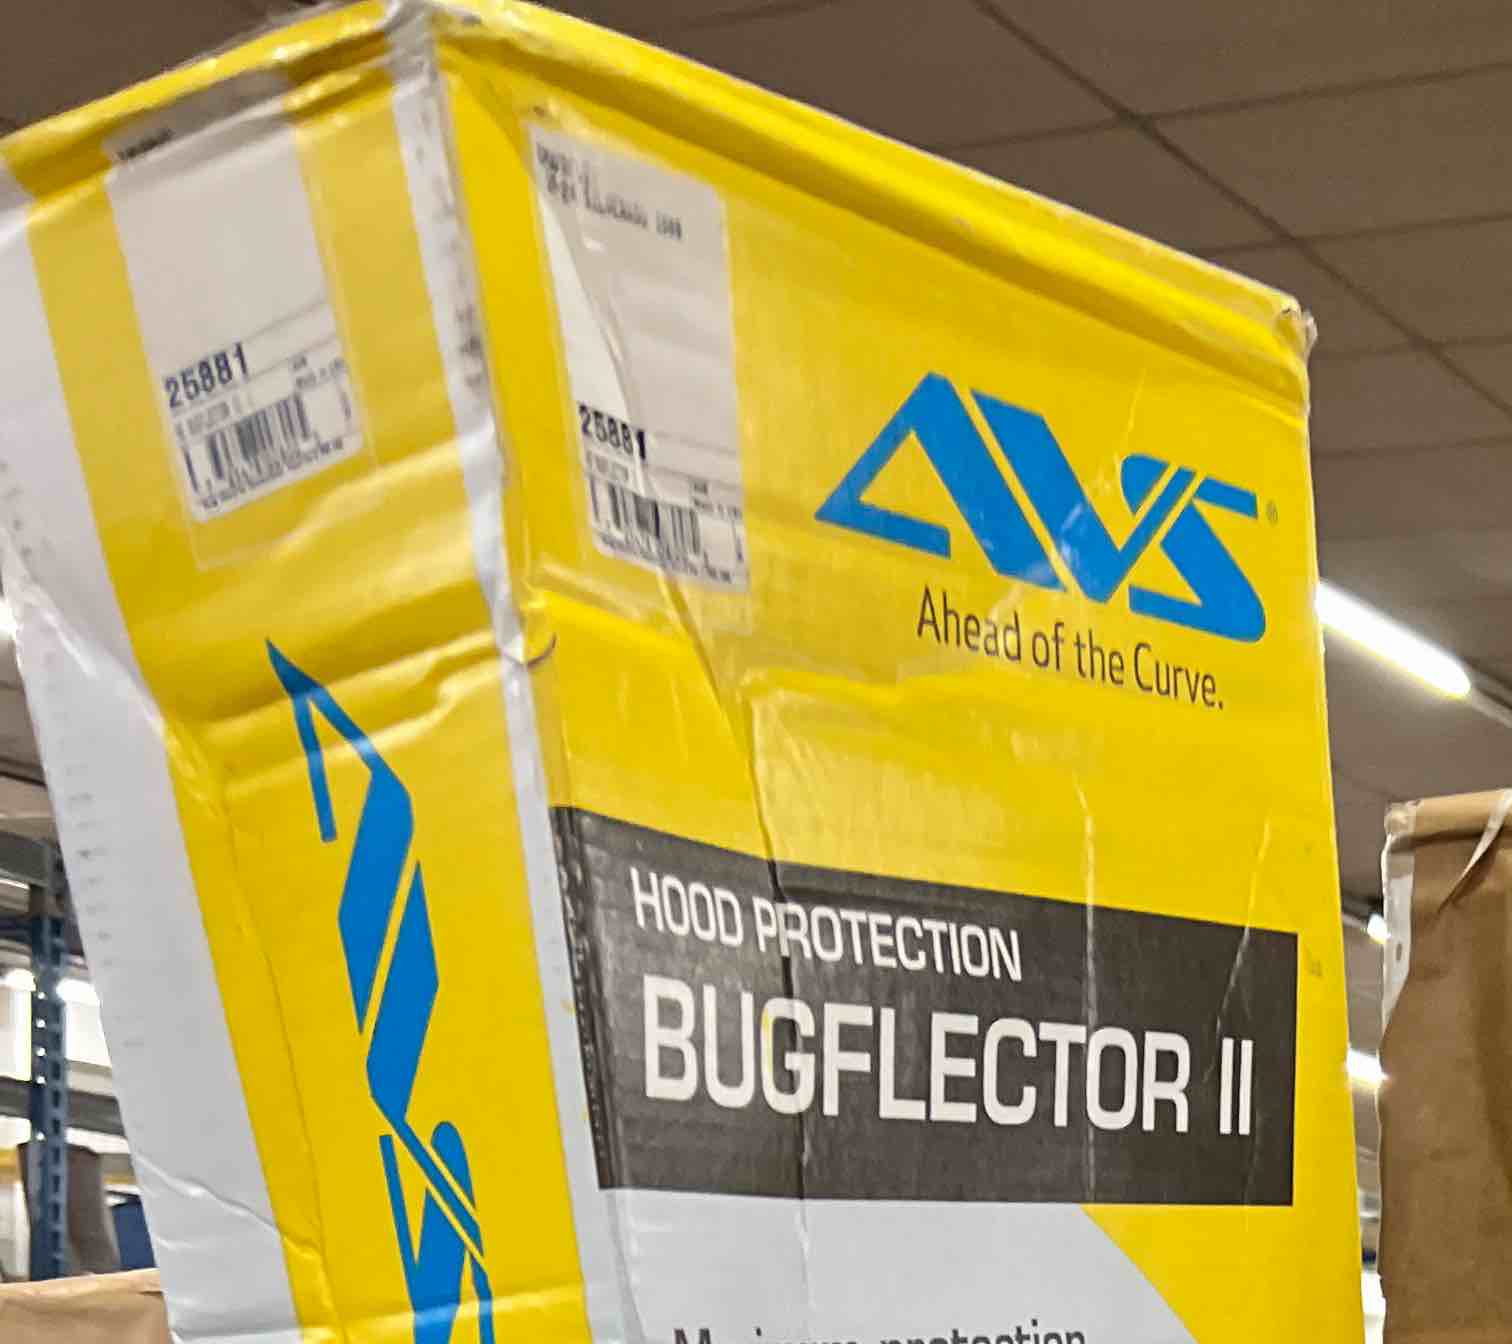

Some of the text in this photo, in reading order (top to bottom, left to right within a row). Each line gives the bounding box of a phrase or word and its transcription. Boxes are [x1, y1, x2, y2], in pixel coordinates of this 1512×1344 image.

[165, 341, 248, 409] 25881
[578, 404, 646, 460] 25881
[815, 372, 1266, 643] AVS
[917, 584, 1224, 710] Ahead of the Curve.
[630, 867, 1022, 982] HOOD PROTECTION
[642, 974, 1254, 1136] BUGFLECTOR II
